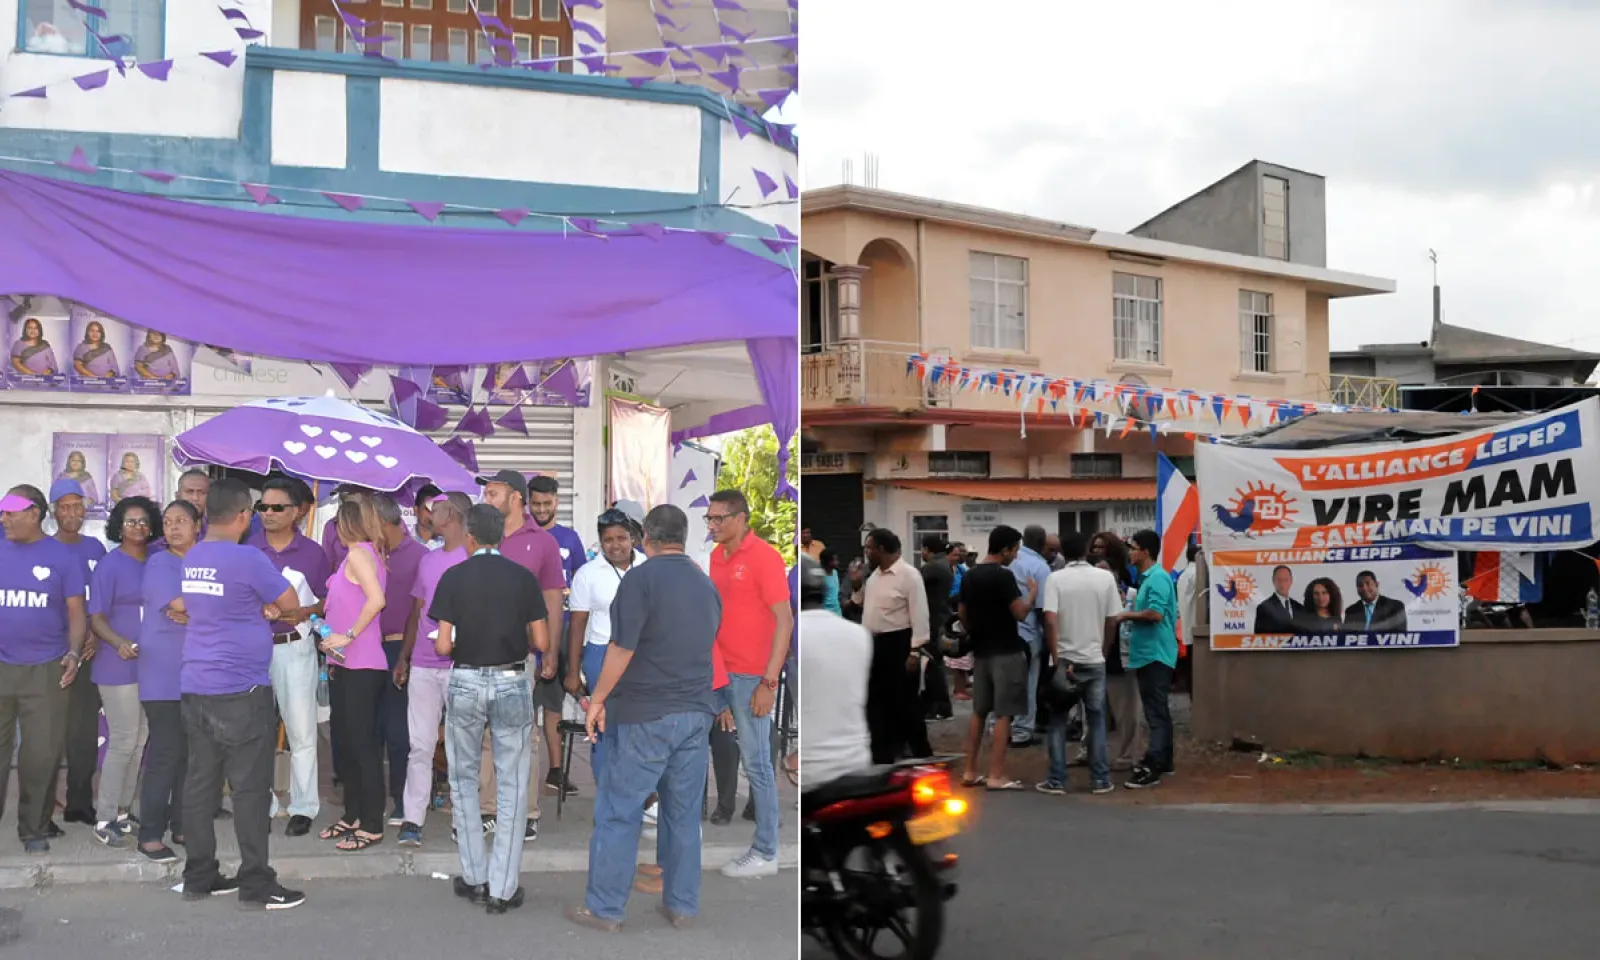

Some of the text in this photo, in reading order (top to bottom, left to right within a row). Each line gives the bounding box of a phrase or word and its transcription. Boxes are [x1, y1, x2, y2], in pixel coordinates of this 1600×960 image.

[1302, 421, 1566, 481] L'ALLIANCE LEPEP
[1311, 458, 1577, 526] VIRE MAM
[1310, 514, 1572, 548] SANZMAN PE VINI
[1256, 547, 1402, 564] L'ALLIANCE LEPEP
[184, 567, 217, 581] VOTEZ
[1224, 610, 1246, 618] VIRE
[1224, 622, 1246, 630] MAM
[1241, 632, 1421, 648] SANZMAN PE VINI
